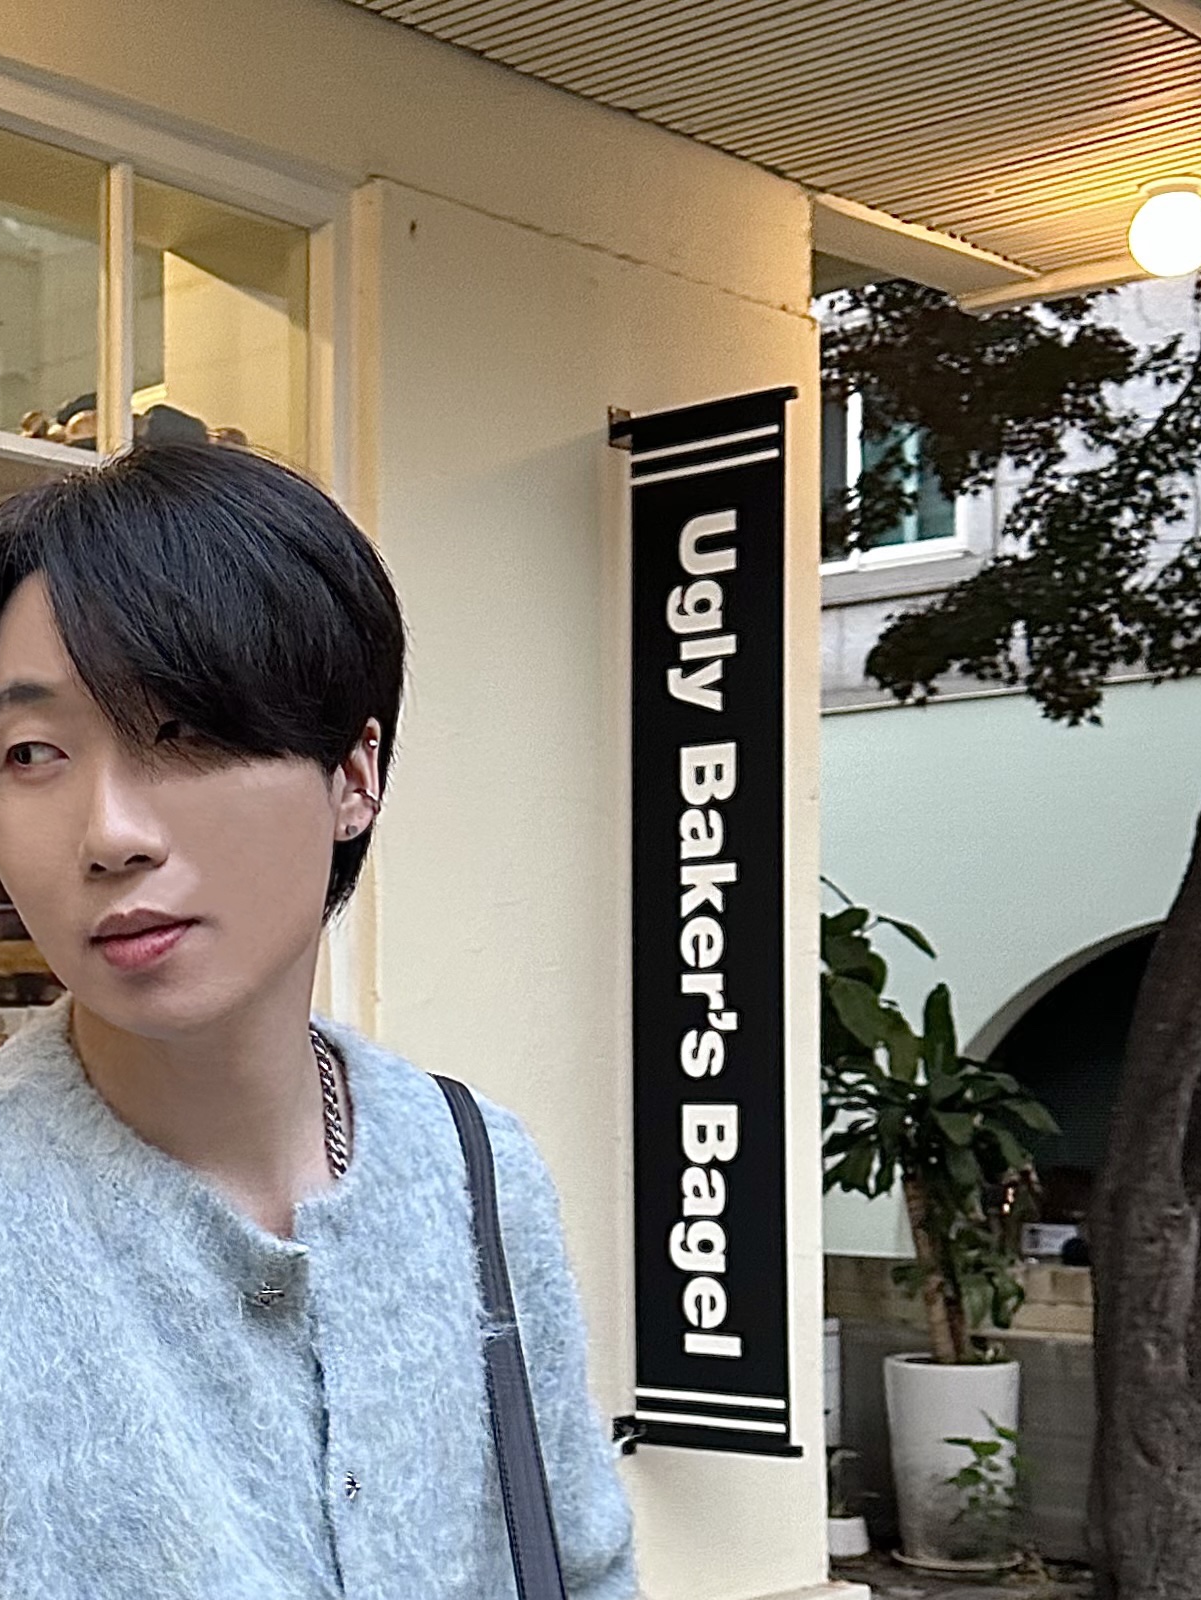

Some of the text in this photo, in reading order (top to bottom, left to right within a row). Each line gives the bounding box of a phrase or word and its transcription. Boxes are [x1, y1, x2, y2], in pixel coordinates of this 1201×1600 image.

[666, 508, 742, 1358] Ugly Baker's Bagel
